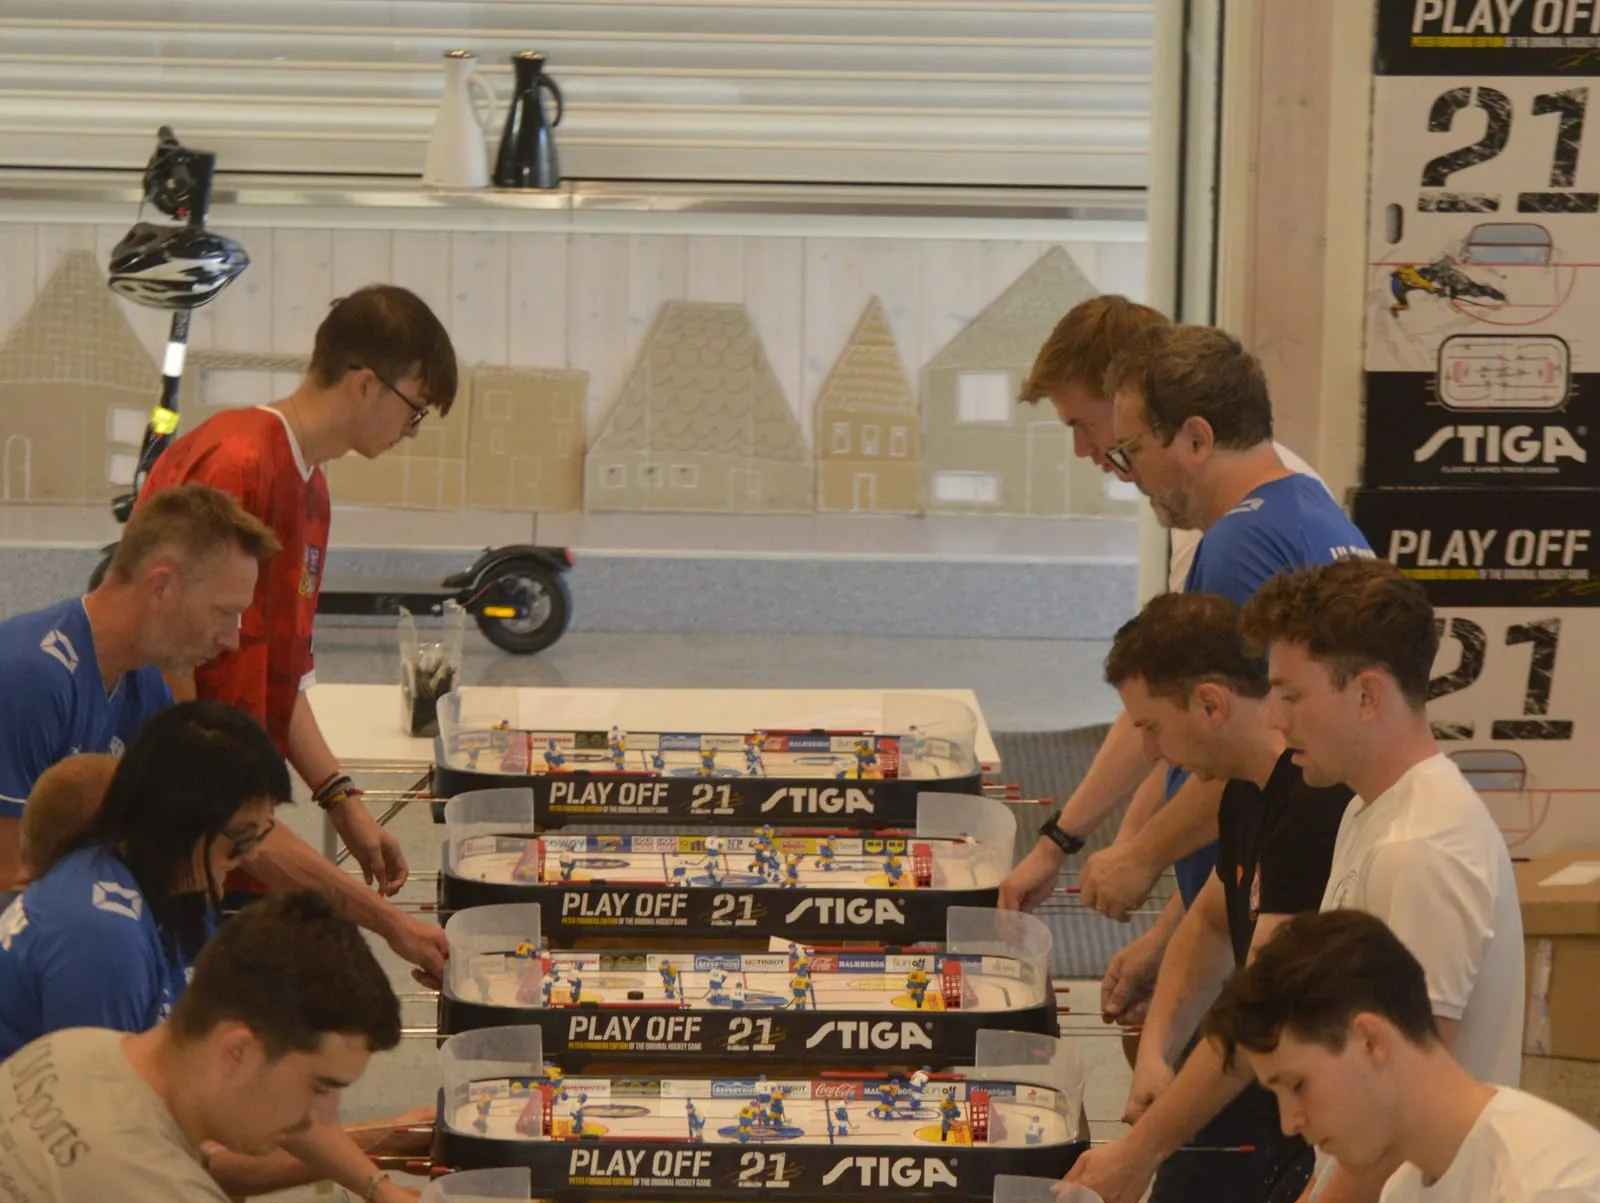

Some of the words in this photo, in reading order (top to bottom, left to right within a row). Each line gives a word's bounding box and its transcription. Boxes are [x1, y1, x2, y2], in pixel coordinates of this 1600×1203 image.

[1411, 0, 1514, 34] PLAY
[1419, 87, 1592, 200] 21
[1414, 425, 1588, 463] STIGA
[1389, 529, 1498, 567] PLAY
[1504, 529, 1592, 567] OFF
[549, 781, 613, 805] PLAY
[618, 782, 669, 805] OFF
[691, 783, 735, 814] 21
[761, 787, 874, 814] STIGA
[562, 892, 629, 917] PLAY
[635, 893, 688, 917] OFF
[711, 893, 757, 926] 21
[785, 897, 905, 925] STIGA
[568, 1015, 640, 1041] PLAY
[646, 1016, 702, 1042] OFF
[727, 1016, 776, 1051] 21
[806, 1021, 933, 1050] STIGA
[569, 1149, 646, 1177] PLAY
[652, 1150, 712, 1177] OFF
[738, 1151, 790, 1188] 21
[822, 1156, 958, 1188] STIGA
